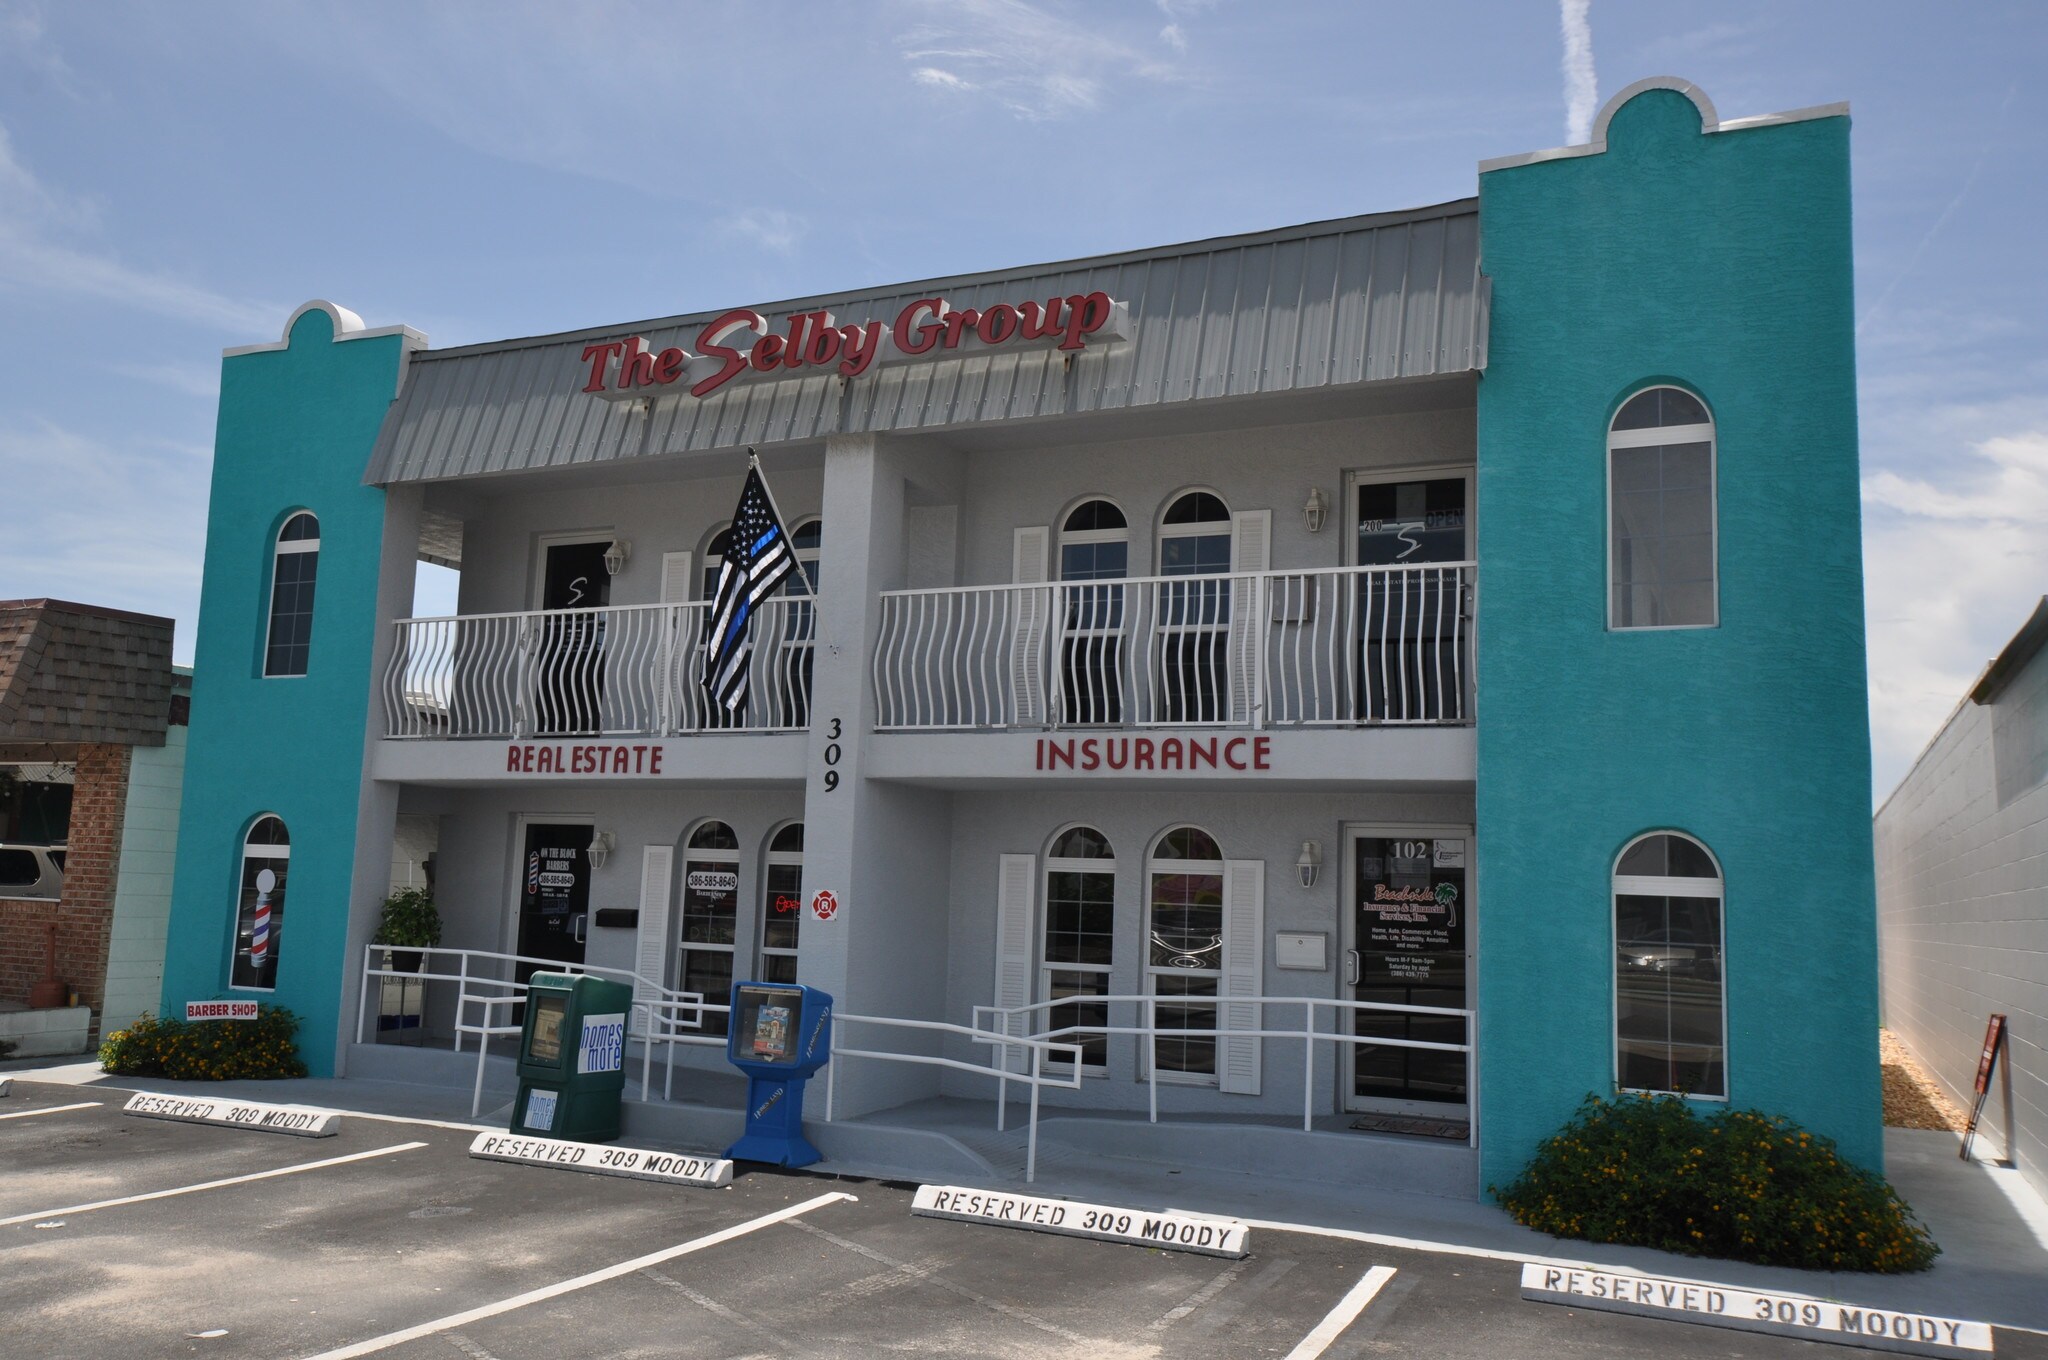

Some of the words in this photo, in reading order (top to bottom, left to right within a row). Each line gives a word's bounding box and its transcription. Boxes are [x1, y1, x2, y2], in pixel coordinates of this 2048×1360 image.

[581, 336, 684, 393] The
[691, 309, 883, 398] Selby
[894, 291, 1110, 355] Group
[1364, 521, 1382, 532] 200
[1426, 509, 1466, 528] OPEN
[1036, 736, 1270, 771] INSURANCE
[541, 848, 548, 858] ON
[549, 848, 559, 858] THE
[560, 848, 576, 859] BLOCK
[1393, 841, 1427, 859] 102
[546, 860, 570, 871] BARBERS
[540, 874, 574, 885] 386-585-8649
[689, 874, 736, 887] 386-585-8649
[1374, 884, 1435, 901] Beachside
[1363, 902, 1399, 912] Insurance
[1400, 902, 1409, 912] &
[1409, 903, 1446, 914] Financial
[1380, 911, 1412, 923] Services,
[1412, 912, 1428, 922] Inc.
[1389, 963, 1411, 971] Saturday
[187, 1003, 229, 1018] BARBER
[231, 1003, 257, 1017] SHOP
[580, 1023, 623, 1049] homes
[587, 1046, 621, 1071] more
[131, 1095, 215, 1119] RESERVED
[226, 1107, 260, 1123] 309
[261, 1111, 321, 1130] MOODY
[528, 1093, 556, 1114] homes
[531, 1111, 553, 1129] more
[482, 1136, 586, 1164] RESERVED
[599, 1149, 639, 1169] 309
[642, 1154, 715, 1179] MOODY
[933, 1190, 1066, 1226] RESERVED
[1082, 1210, 1132, 1235] 309
[1141, 1218, 1232, 1249] MOODY
[1544, 1269, 1726, 1314] RESERVED
[1755, 1298, 1822, 1328] 309
[1839, 1307, 1964, 1346] MOODY
